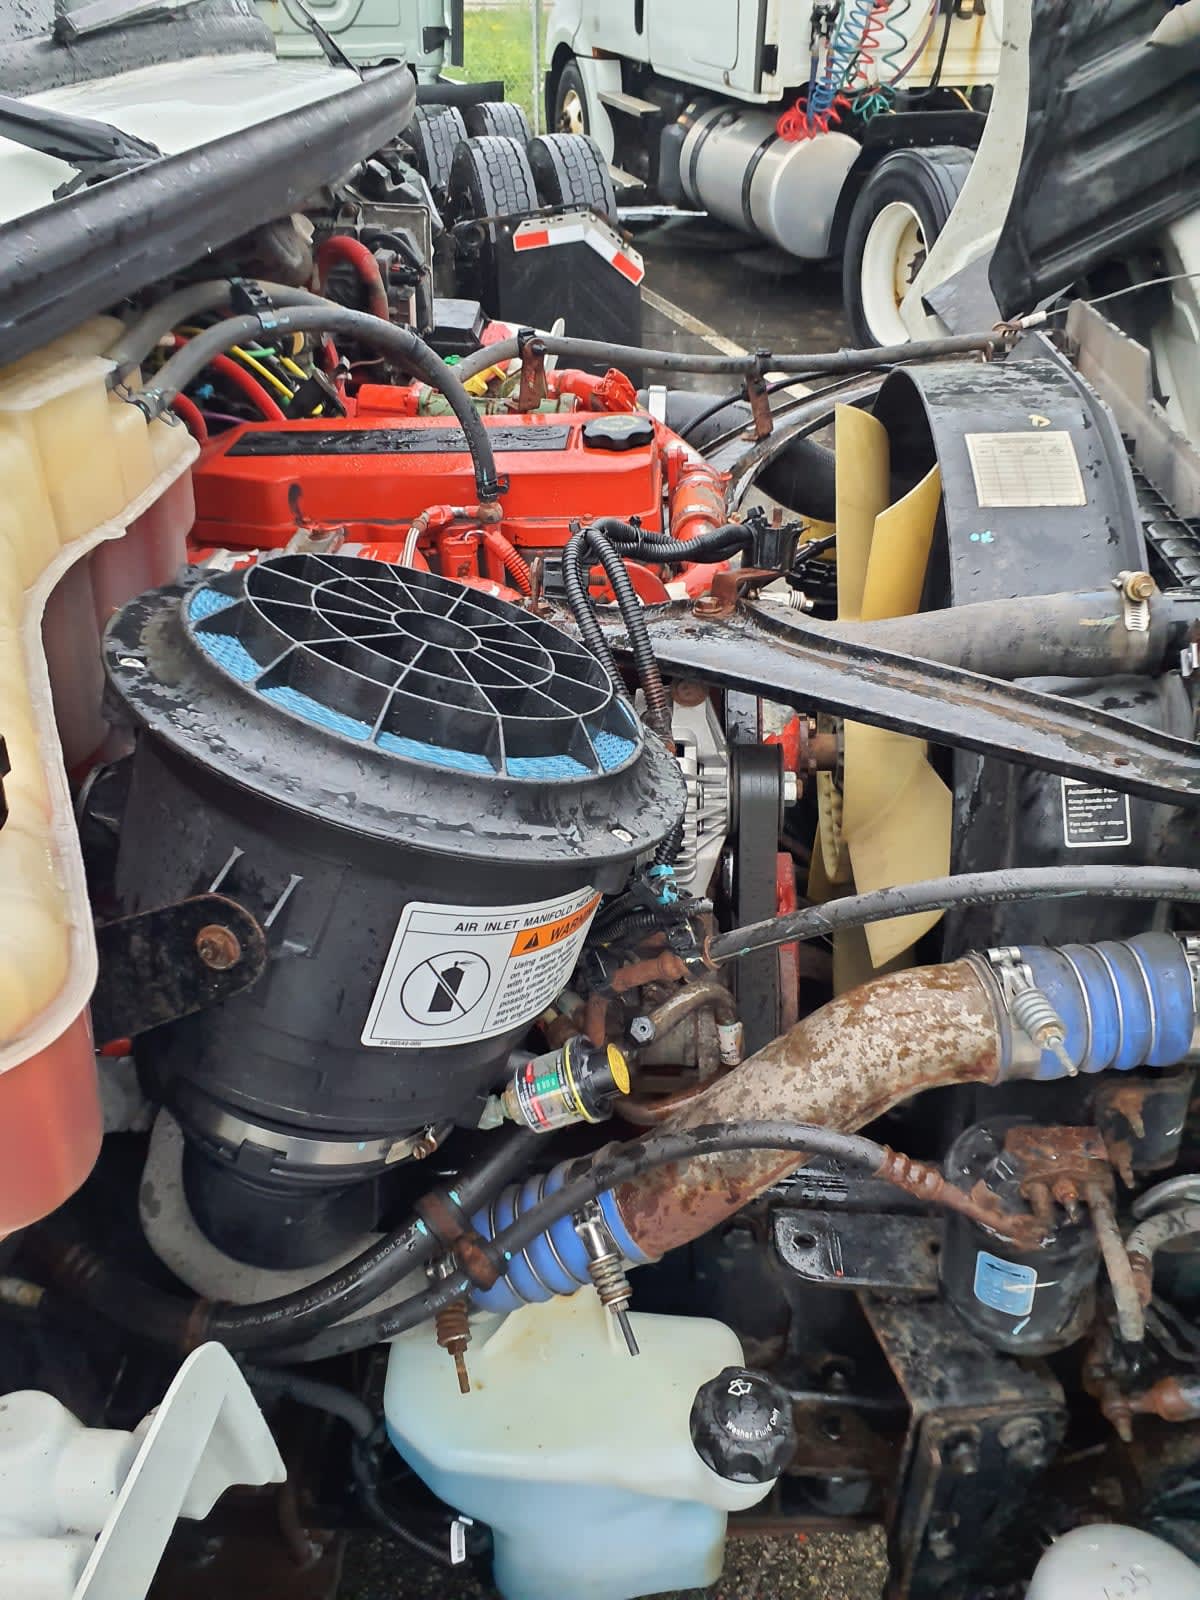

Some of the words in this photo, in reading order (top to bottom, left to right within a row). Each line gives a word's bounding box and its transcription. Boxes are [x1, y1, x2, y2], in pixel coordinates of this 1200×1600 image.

[454, 922, 479, 932] AIR
[484, 919, 520, 932] INLET
[523, 904, 573, 928] MANIFOLD
[514, 959, 536, 970] Using
